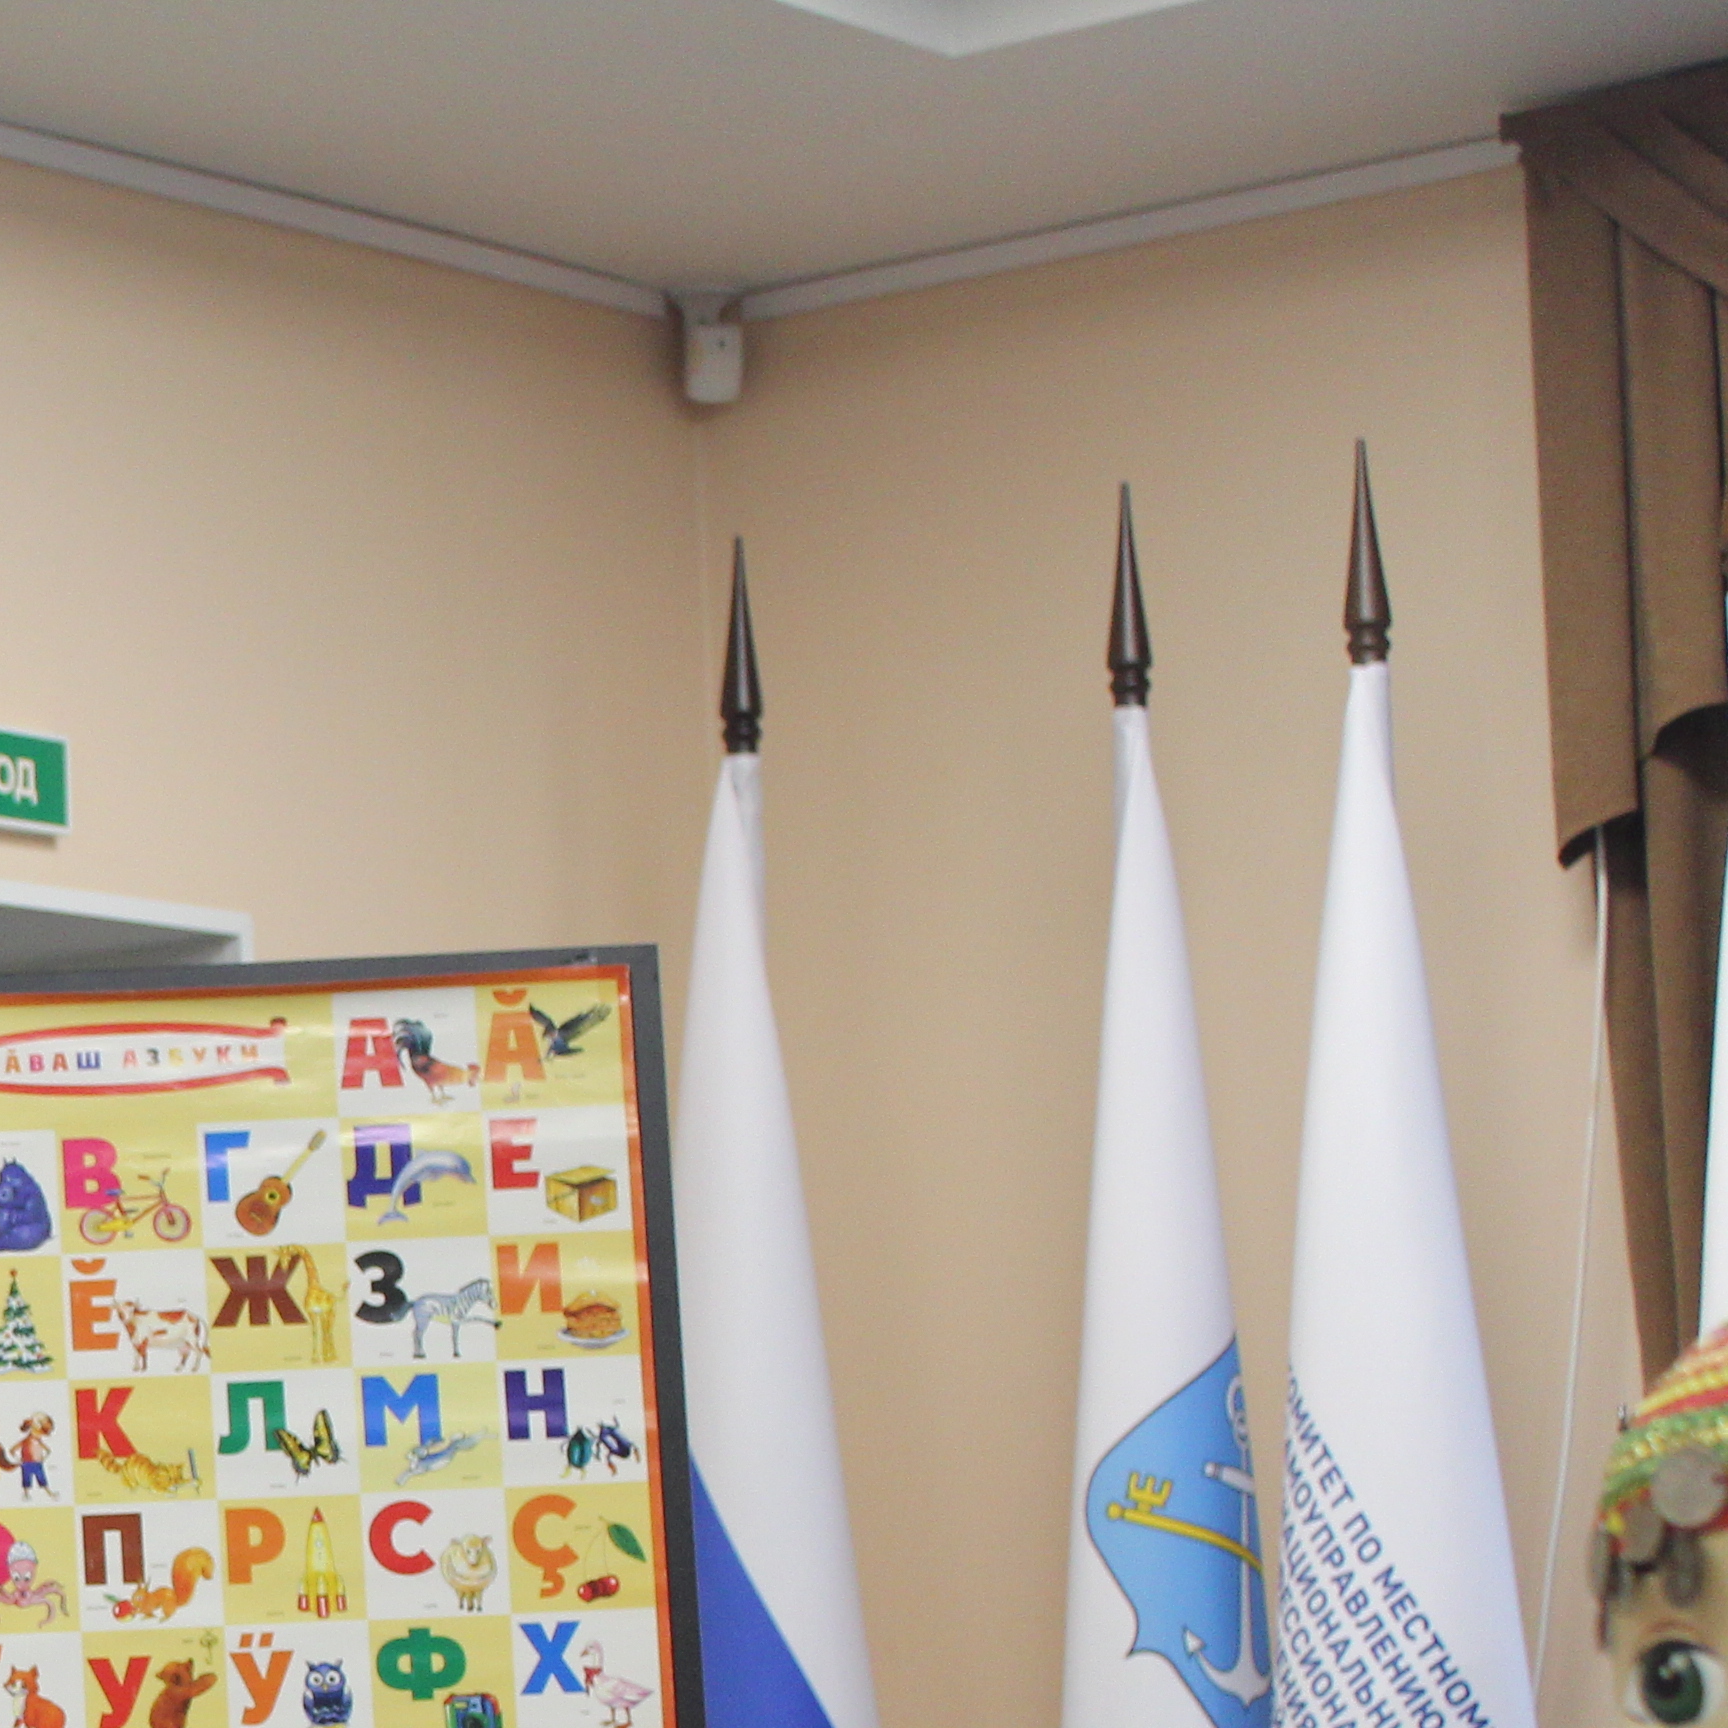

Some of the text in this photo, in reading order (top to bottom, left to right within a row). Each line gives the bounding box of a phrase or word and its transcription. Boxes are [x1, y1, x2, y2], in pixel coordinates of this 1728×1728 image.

[341, 1018, 403, 1090] А
[61, 1139, 119, 1209] В
[204, 1131, 251, 1202] Г
[349, 1124, 423, 1209] Д
[490, 1118, 540, 1190] Е
[211, 1256, 305, 1328] Ж
[355, 1251, 408, 1323] З
[496, 1244, 564, 1315] И
[75, 1387, 134, 1458] К
[218, 1381, 286, 1456] Л
[362, 1374, 442, 1446] М
[504, 1368, 568, 1439] Н
[83, 1513, 143, 1585] П
[224, 1507, 285, 1583] Р
[369, 1501, 432, 1575] С
[1343, 1510, 1382, 1564] ПО
[377, 1627, 464, 1700] Ф
[518, 1621, 583, 1695] Х
